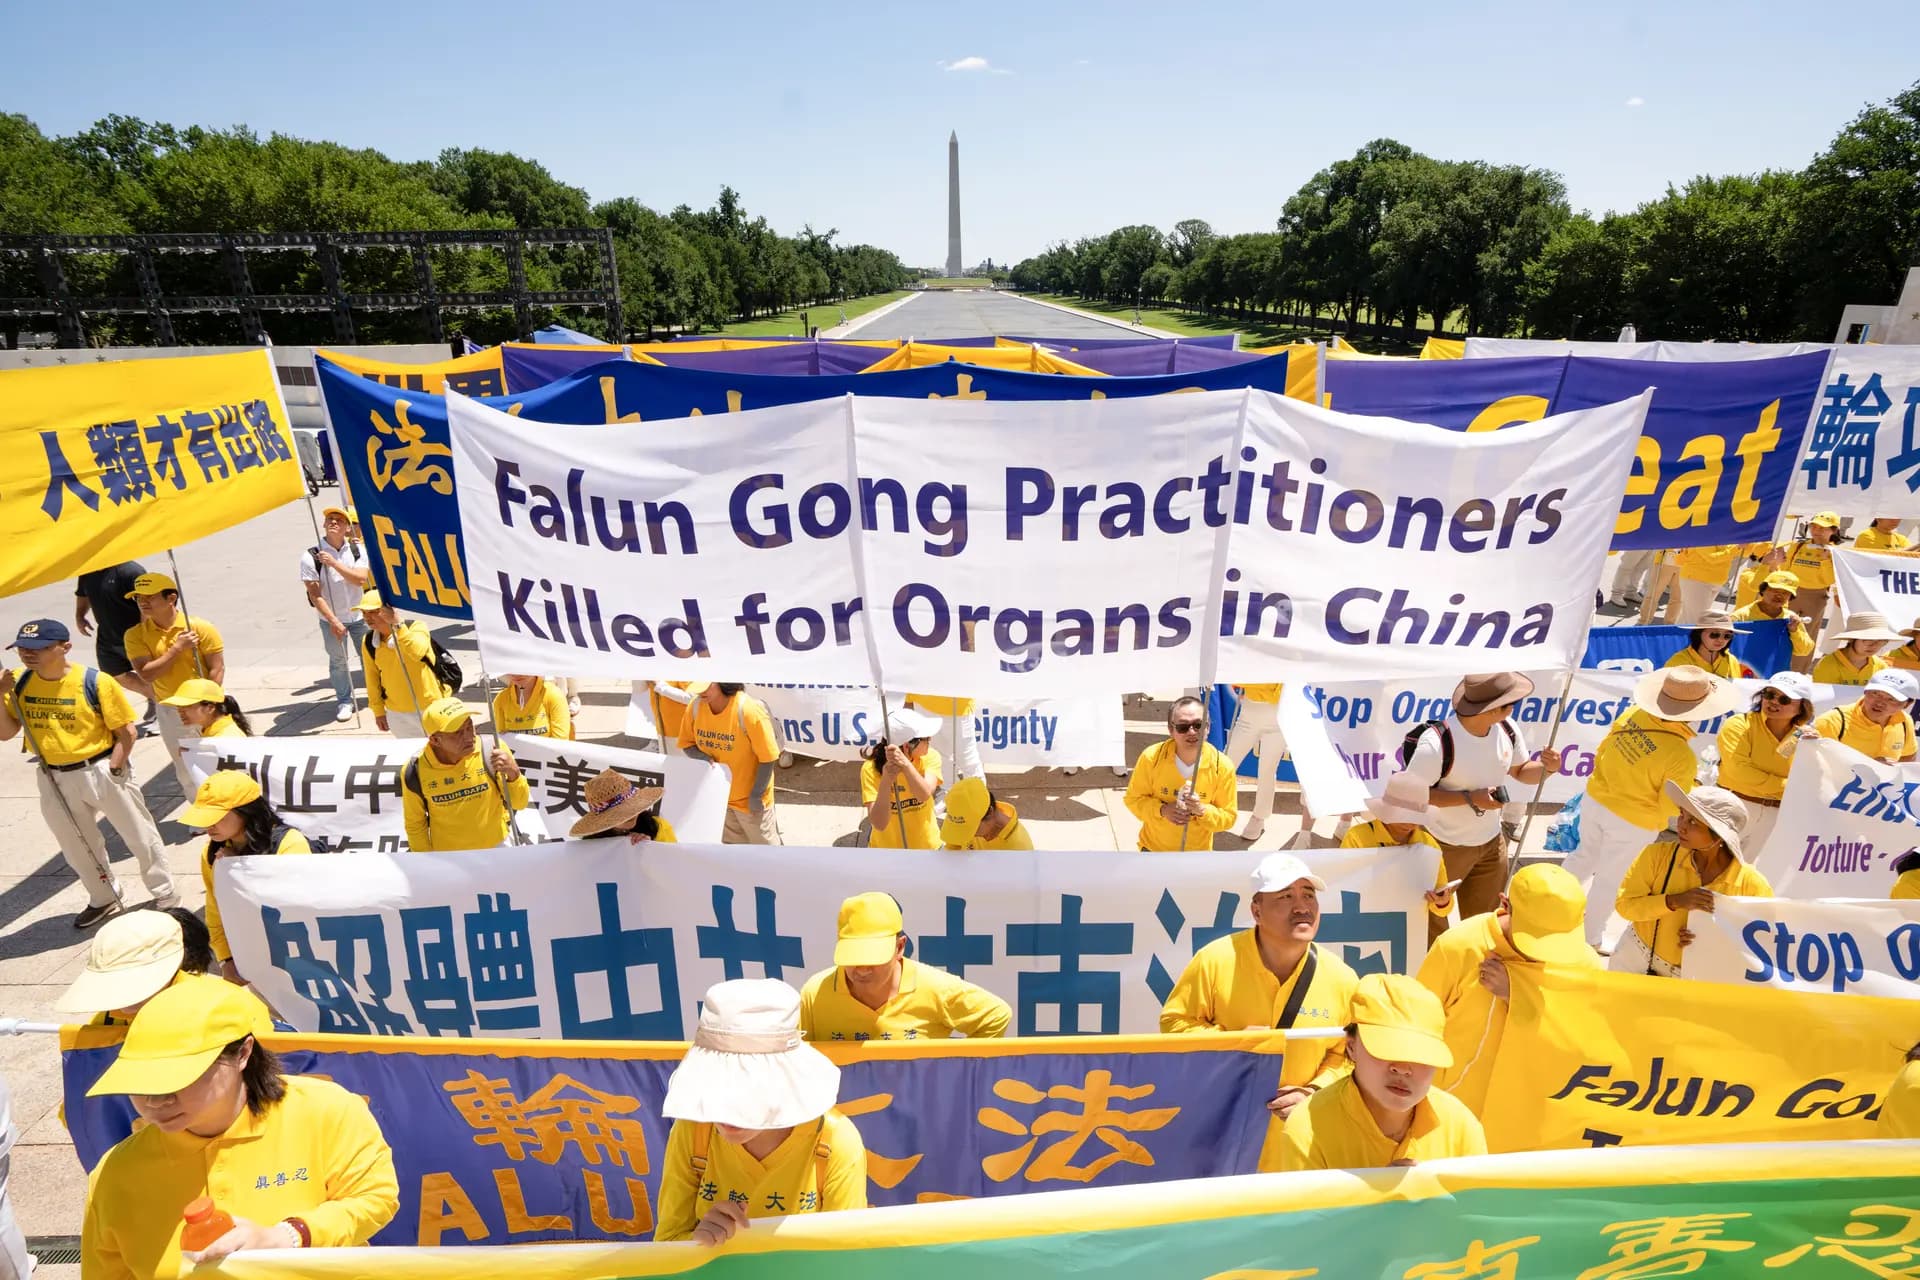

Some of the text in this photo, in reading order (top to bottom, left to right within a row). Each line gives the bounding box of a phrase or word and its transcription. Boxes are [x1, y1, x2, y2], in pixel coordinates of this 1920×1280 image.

[39, 399, 292, 522] 人類才有出路
[494, 446, 1567, 557] Falun Gong Practitioners
[497, 568, 1554, 673] Killed for Organs in China
[822, 712, 878, 746] U.S.
[1303, 685, 1372, 729] Stop
[1799, 836, 1874, 873] Torture
[1742, 919, 1864, 992] Stop
[1548, 1057, 1756, 1118] Falun
